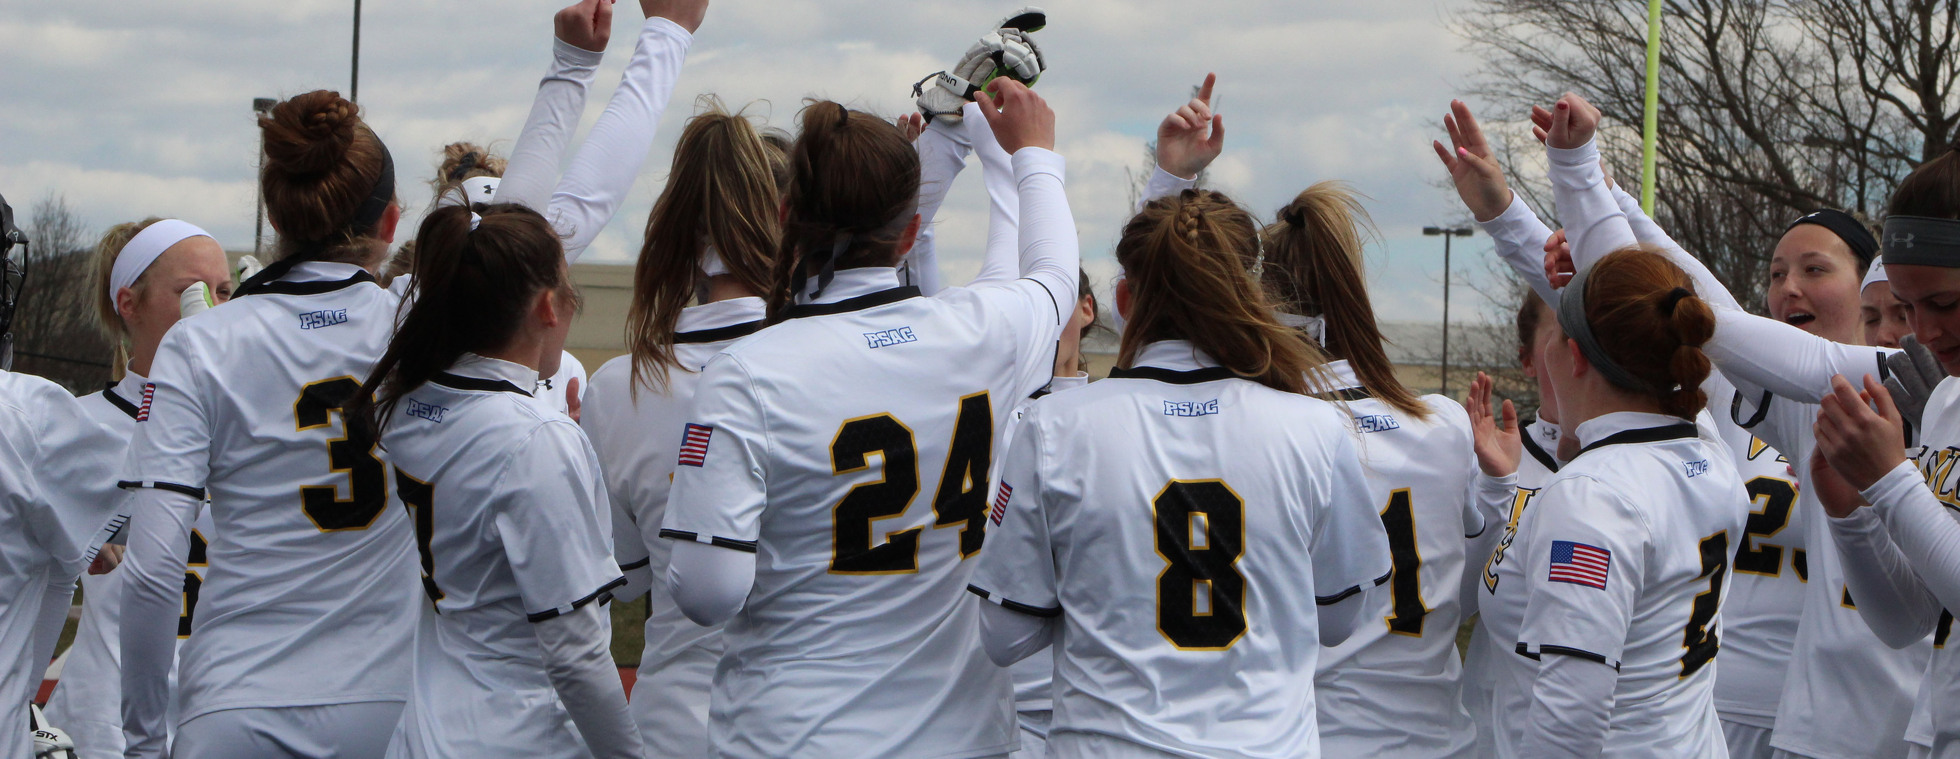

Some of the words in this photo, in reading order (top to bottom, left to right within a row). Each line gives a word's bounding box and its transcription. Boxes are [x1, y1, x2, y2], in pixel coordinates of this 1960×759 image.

[299, 309, 347, 329] PSAC
[863, 326, 917, 349] PSAC
[406, 398, 449, 424] PSA
[1164, 399, 1218, 417] PSAC
[293, 375, 388, 532] 3
[828, 389, 993, 575] 24
[1152, 478, 1249, 651] 8
[35, 730, 58, 742] STX
